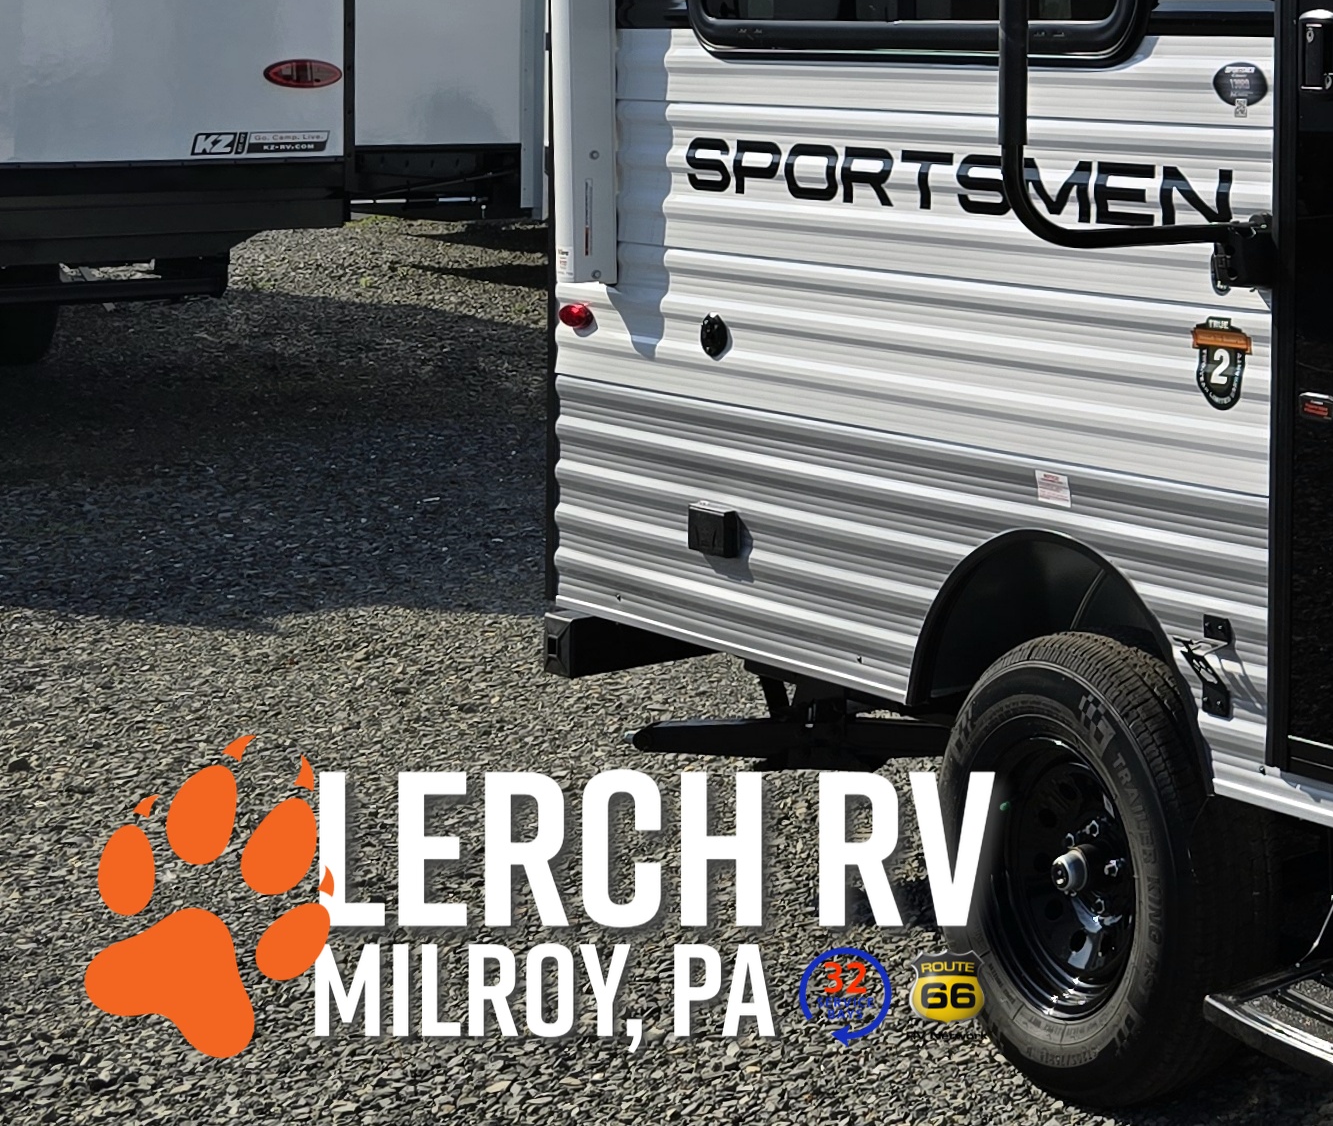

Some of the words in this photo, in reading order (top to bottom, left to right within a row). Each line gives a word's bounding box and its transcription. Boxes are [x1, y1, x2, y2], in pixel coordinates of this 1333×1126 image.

[194, 134, 235, 154] KZ
[263, 143, 315, 151] KZ-RV.COM
[686, 137, 1233, 226] SPORTSMEN
[1208, 319, 1229, 329] TRUE
[1210, 348, 1230, 384] 2
